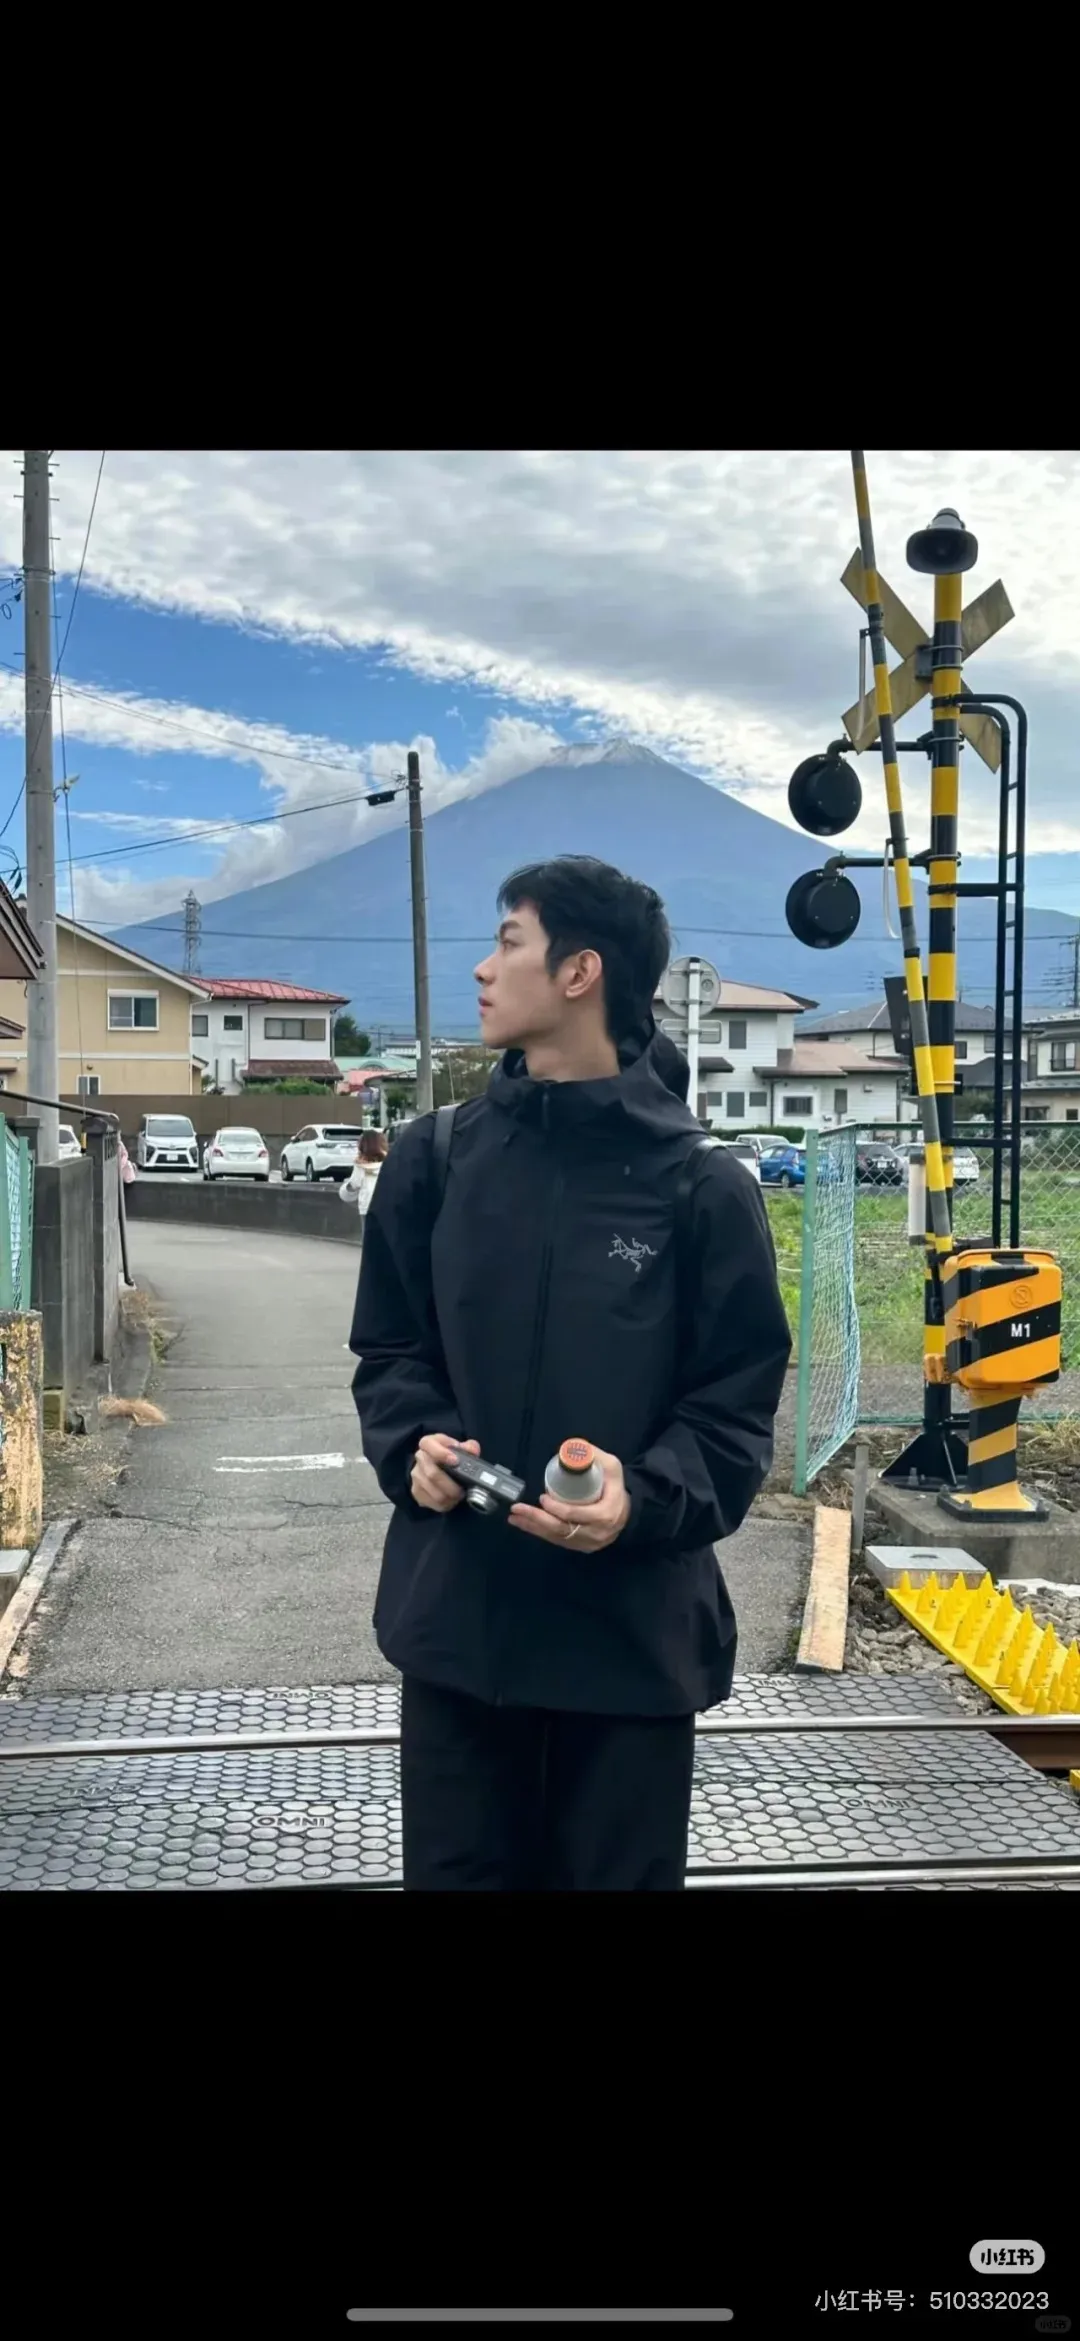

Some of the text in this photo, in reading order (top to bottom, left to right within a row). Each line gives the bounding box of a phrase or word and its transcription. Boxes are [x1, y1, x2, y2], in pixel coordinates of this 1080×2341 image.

[1010, 1322, 1031, 1338] M1
[846, 1798, 911, 1809] OMNI
[257, 1816, 325, 1826] OMNI
